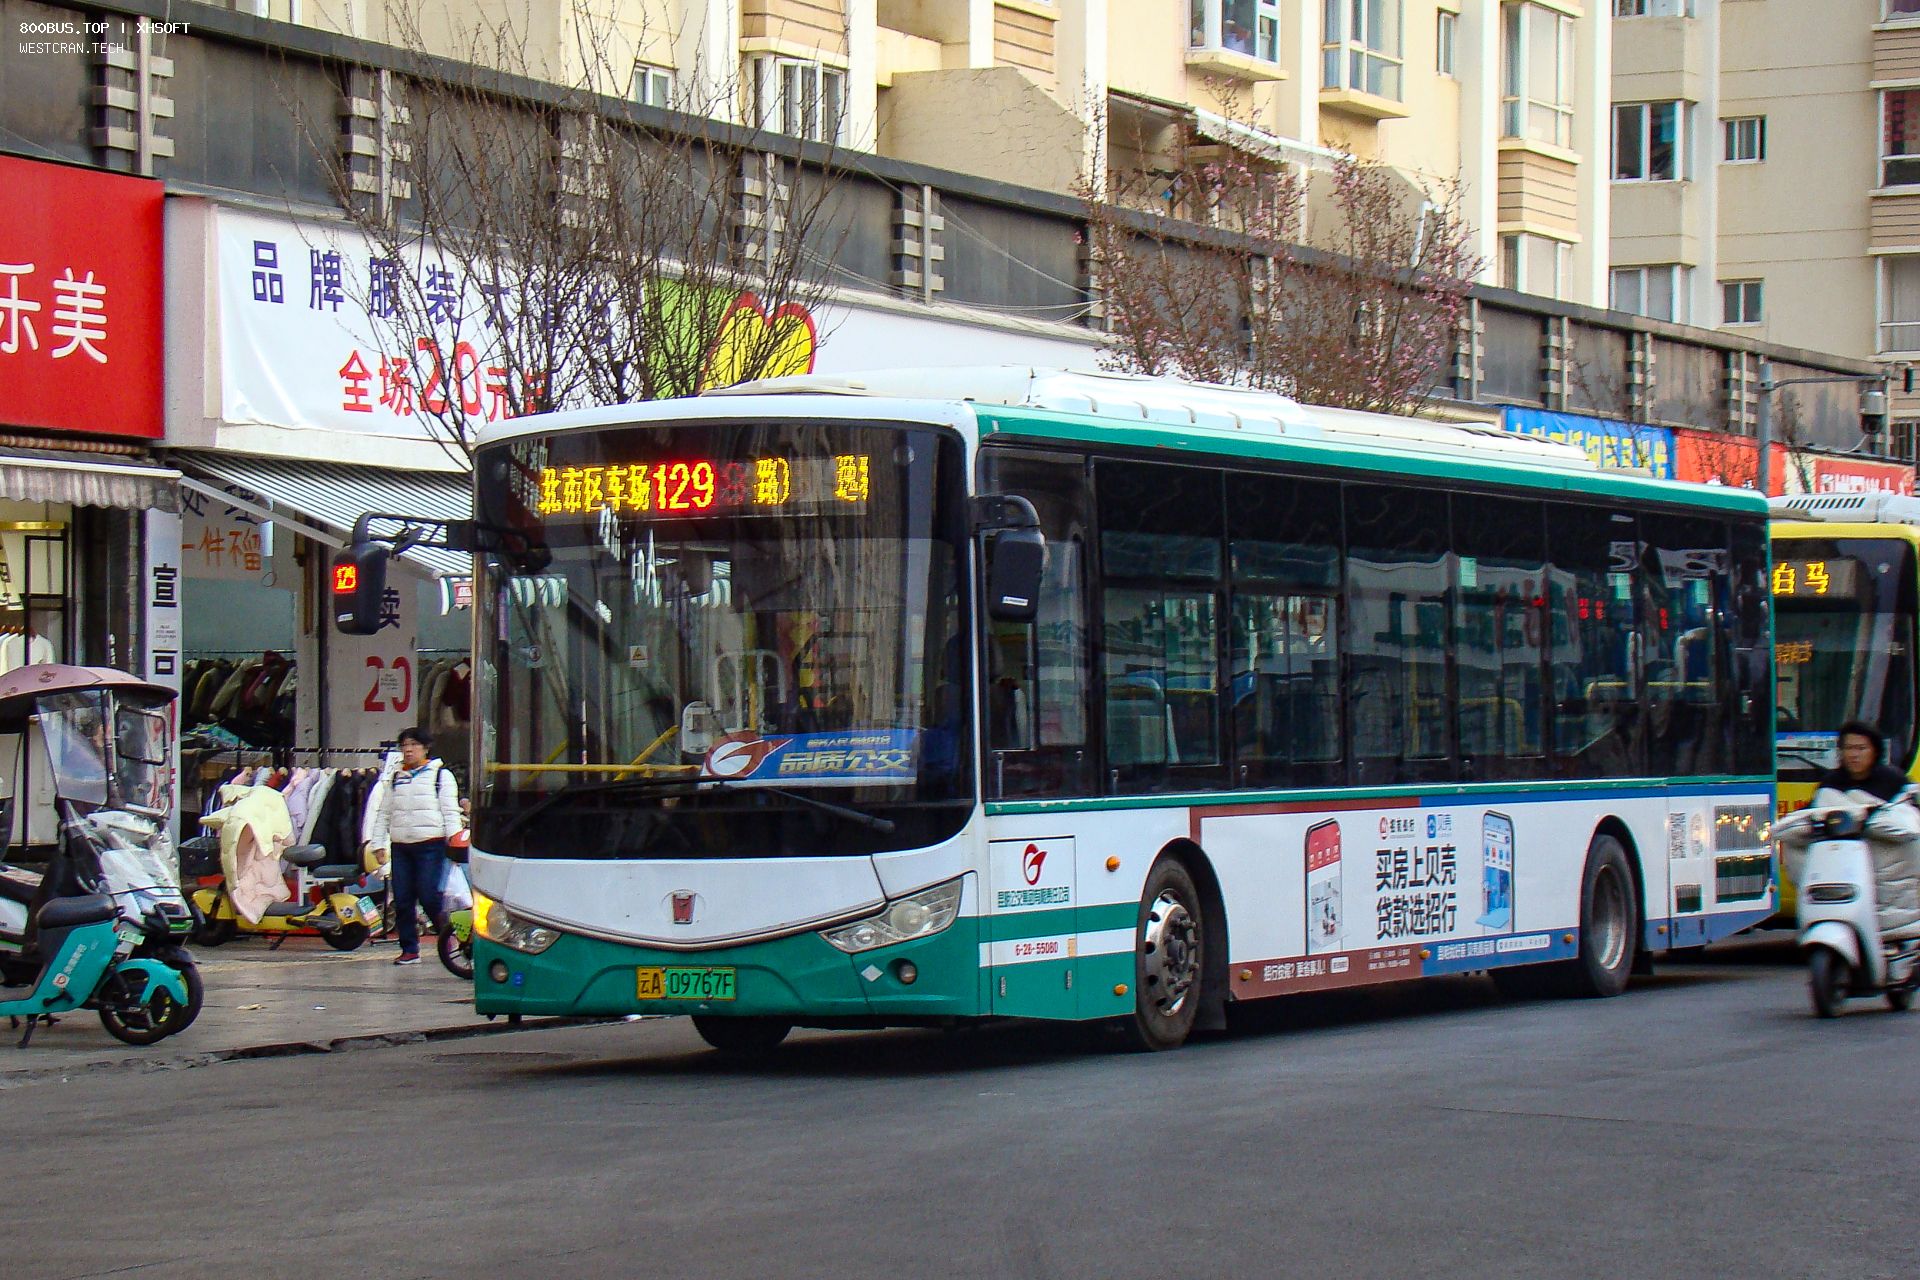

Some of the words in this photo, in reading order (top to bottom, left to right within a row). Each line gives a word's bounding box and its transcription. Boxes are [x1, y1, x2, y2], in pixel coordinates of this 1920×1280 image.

[653, 462, 715, 510] 129
[364, 655, 411, 713] 20
[778, 748, 911, 774] 品质公交
[1375, 843, 1457, 891] 买房上贝壳
[1376, 891, 1457, 941] 贷款选招行
[669, 972, 733, 994] 09767F
